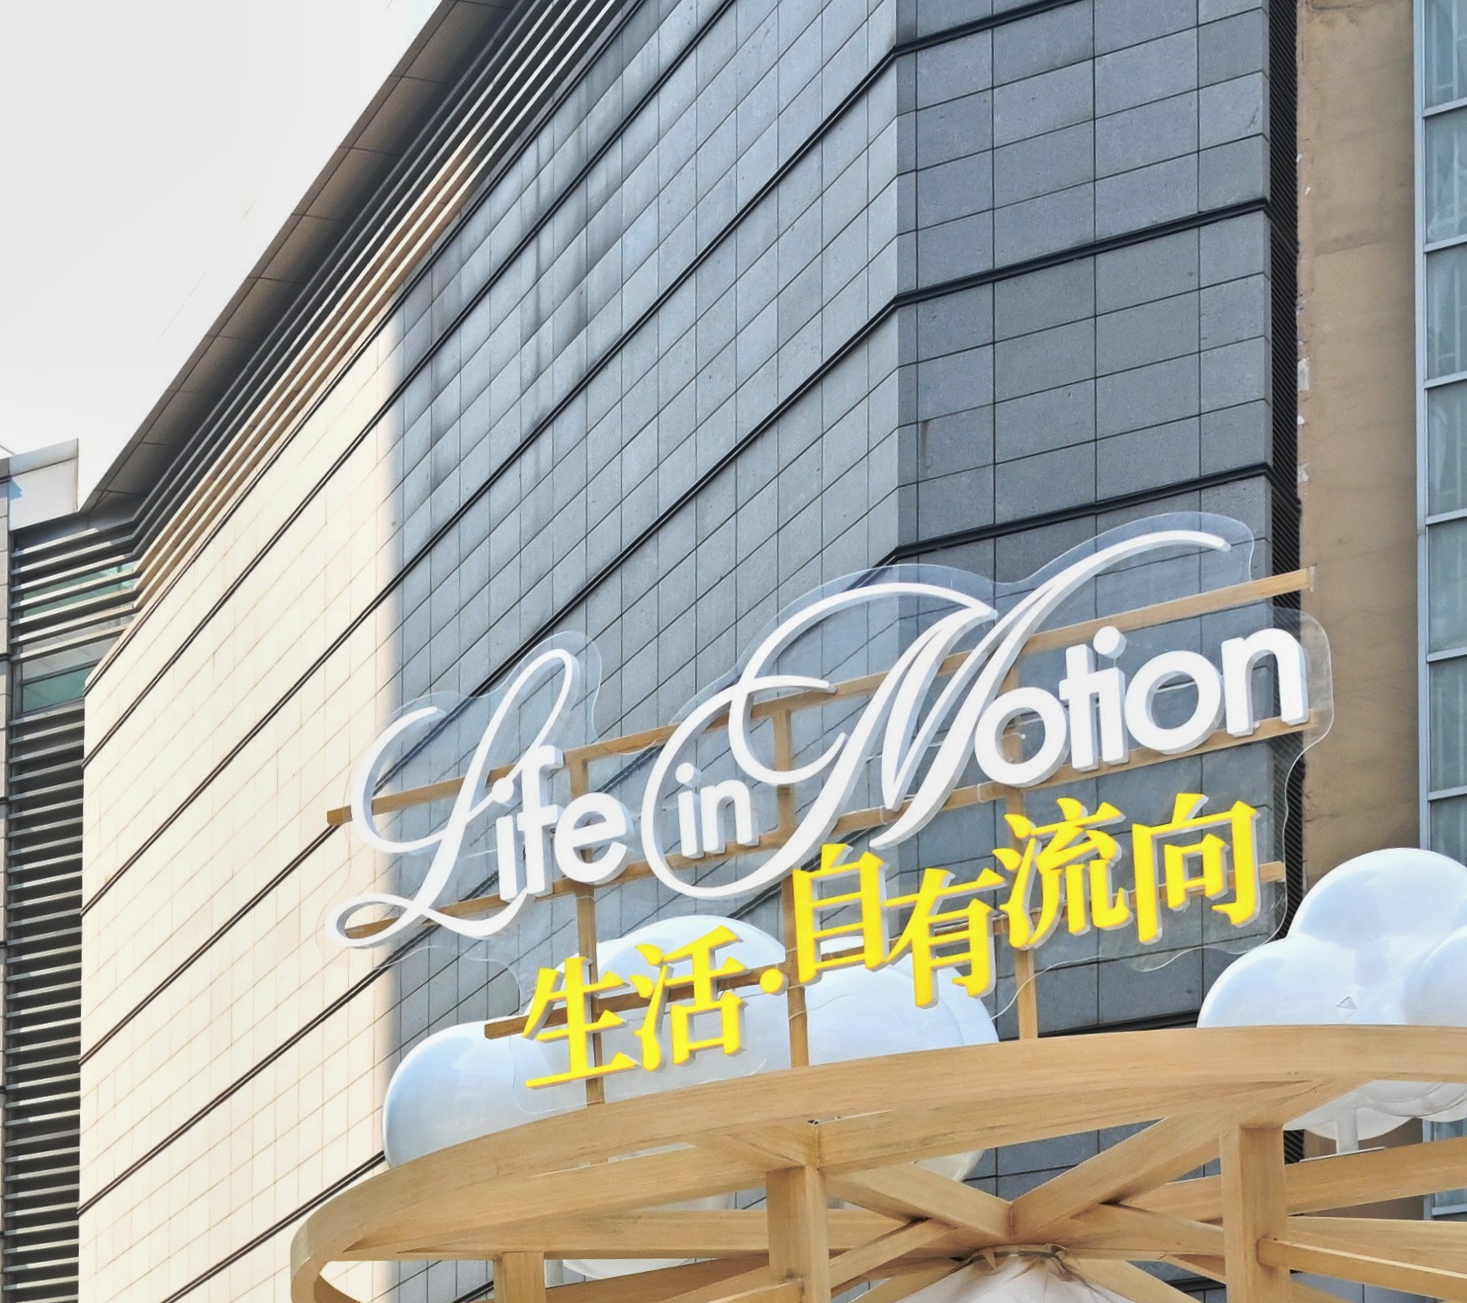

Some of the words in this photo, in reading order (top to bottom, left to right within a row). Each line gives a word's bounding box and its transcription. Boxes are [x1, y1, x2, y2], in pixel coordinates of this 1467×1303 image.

[324, 647, 630, 950] Life
[640, 528, 1310, 902] Motion
[678, 764, 760, 860] in
